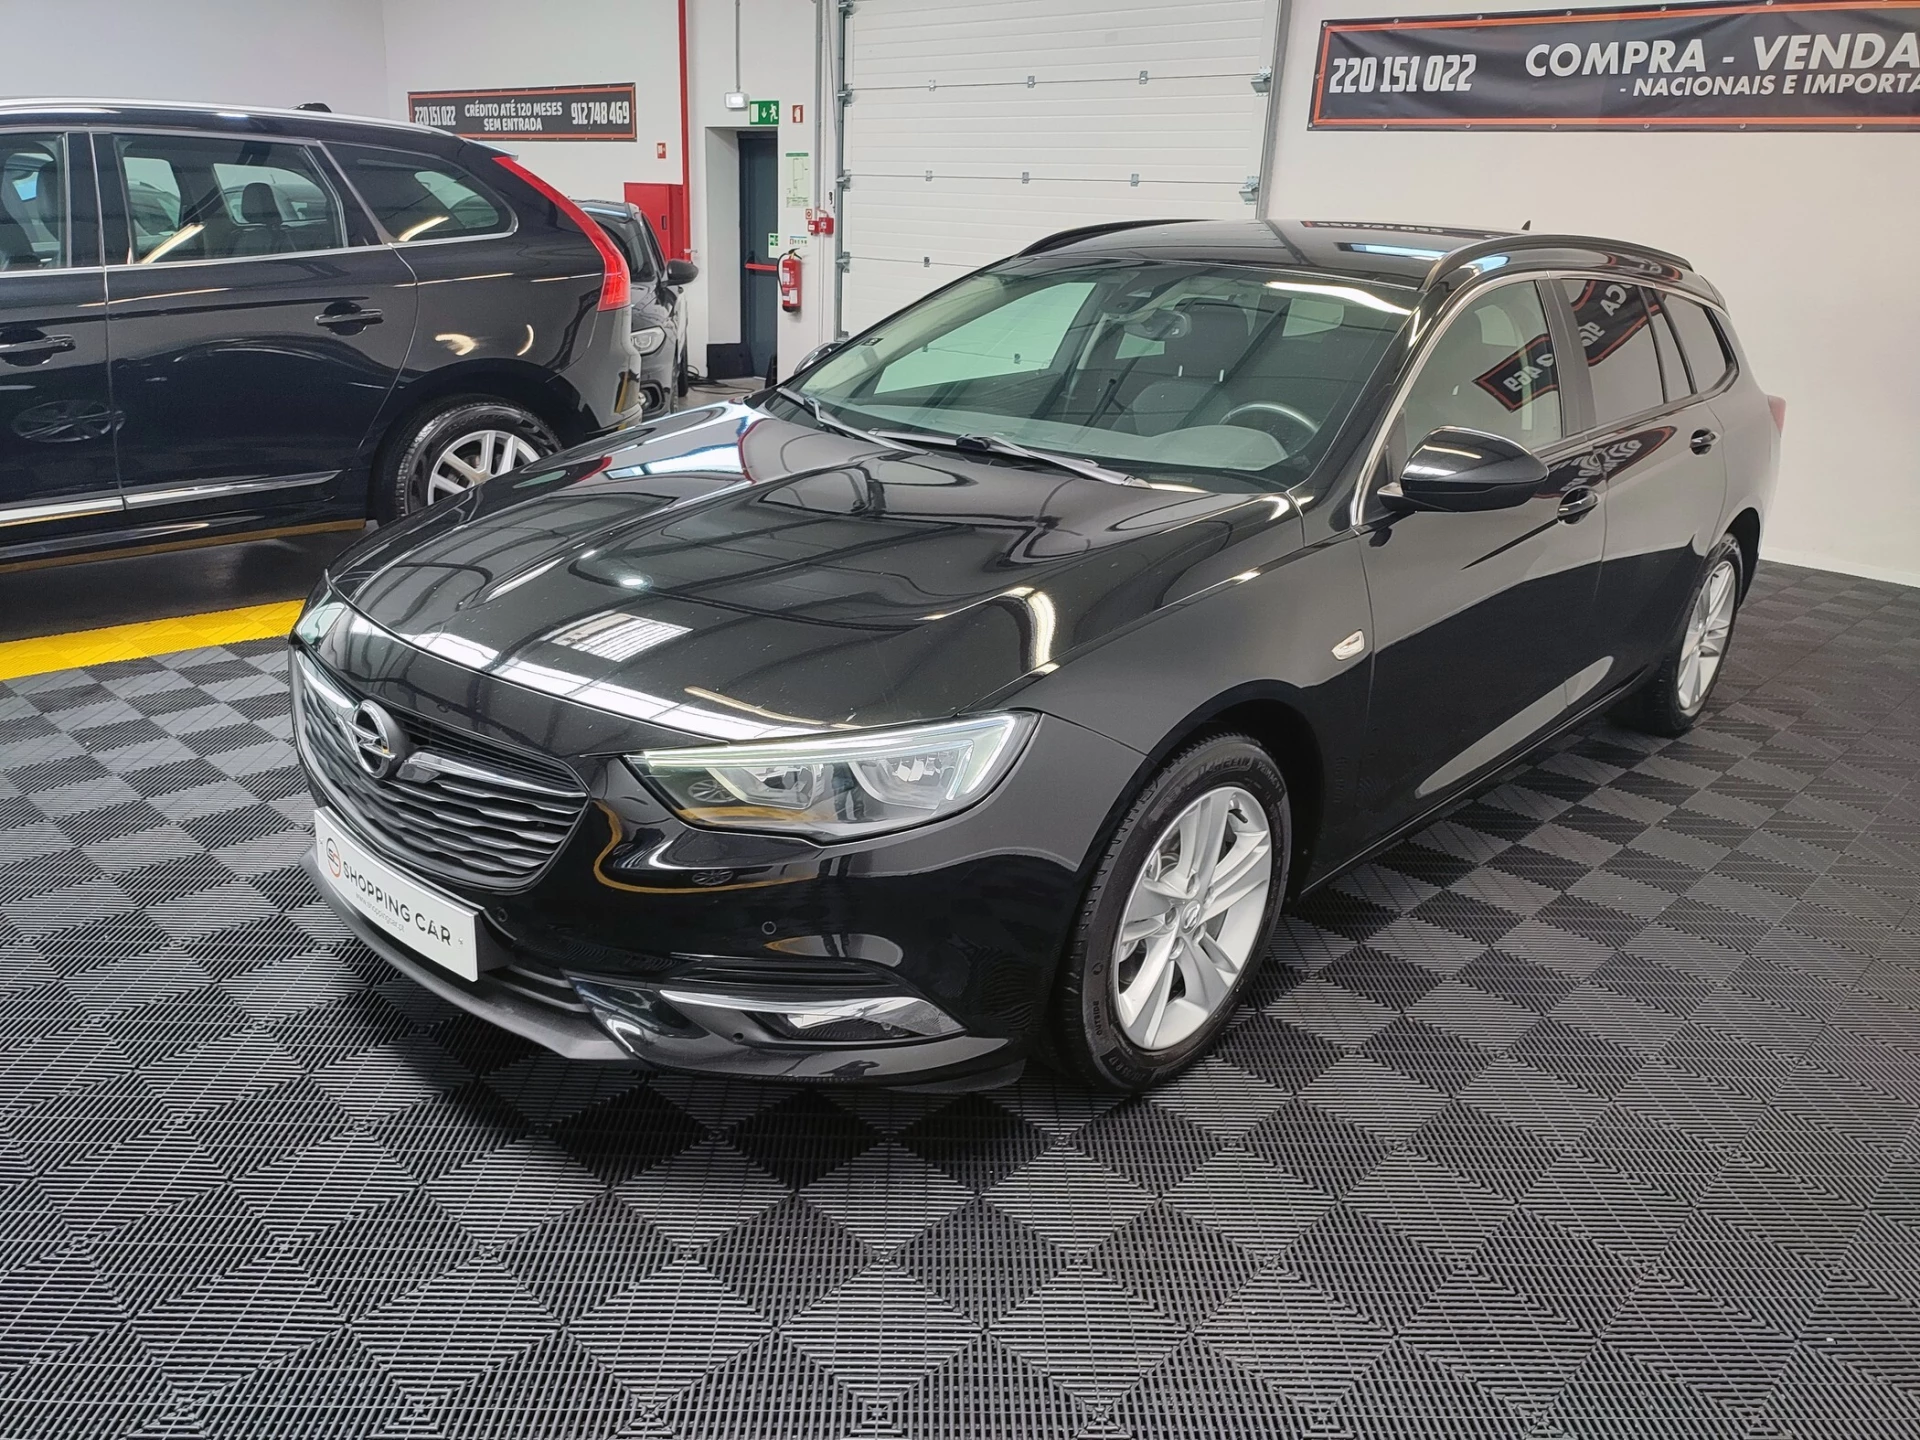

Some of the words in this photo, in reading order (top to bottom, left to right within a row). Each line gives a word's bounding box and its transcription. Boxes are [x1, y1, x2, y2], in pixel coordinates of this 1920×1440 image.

[1525, 38, 1706, 77] COMPRA
[1753, 32, 1920, 71] VENDA
[1329, 57, 1378, 93] 220
[1380, 56, 1421, 93] 151
[1423, 54, 1477, 92] 022
[1633, 75, 1776, 97] NACIONAIS
[1782, 74, 1798, 95] E
[429, 106, 441, 126] 151
[441, 105, 456, 126] 022
[464, 100, 499, 117] CRÉDITO
[500, 99, 516, 117] ATÉ
[517, 102, 532, 116] 120
[533, 102, 563, 116] MESES
[571, 102, 588, 125] 912
[588, 102, 608, 125] 748
[609, 101, 630, 124] 469
[483, 118, 501, 131] SEM
[502, 117, 543, 131] ENTRADA
[343, 861, 411, 922] SHOPPING
[415, 913, 451, 946] CAR
